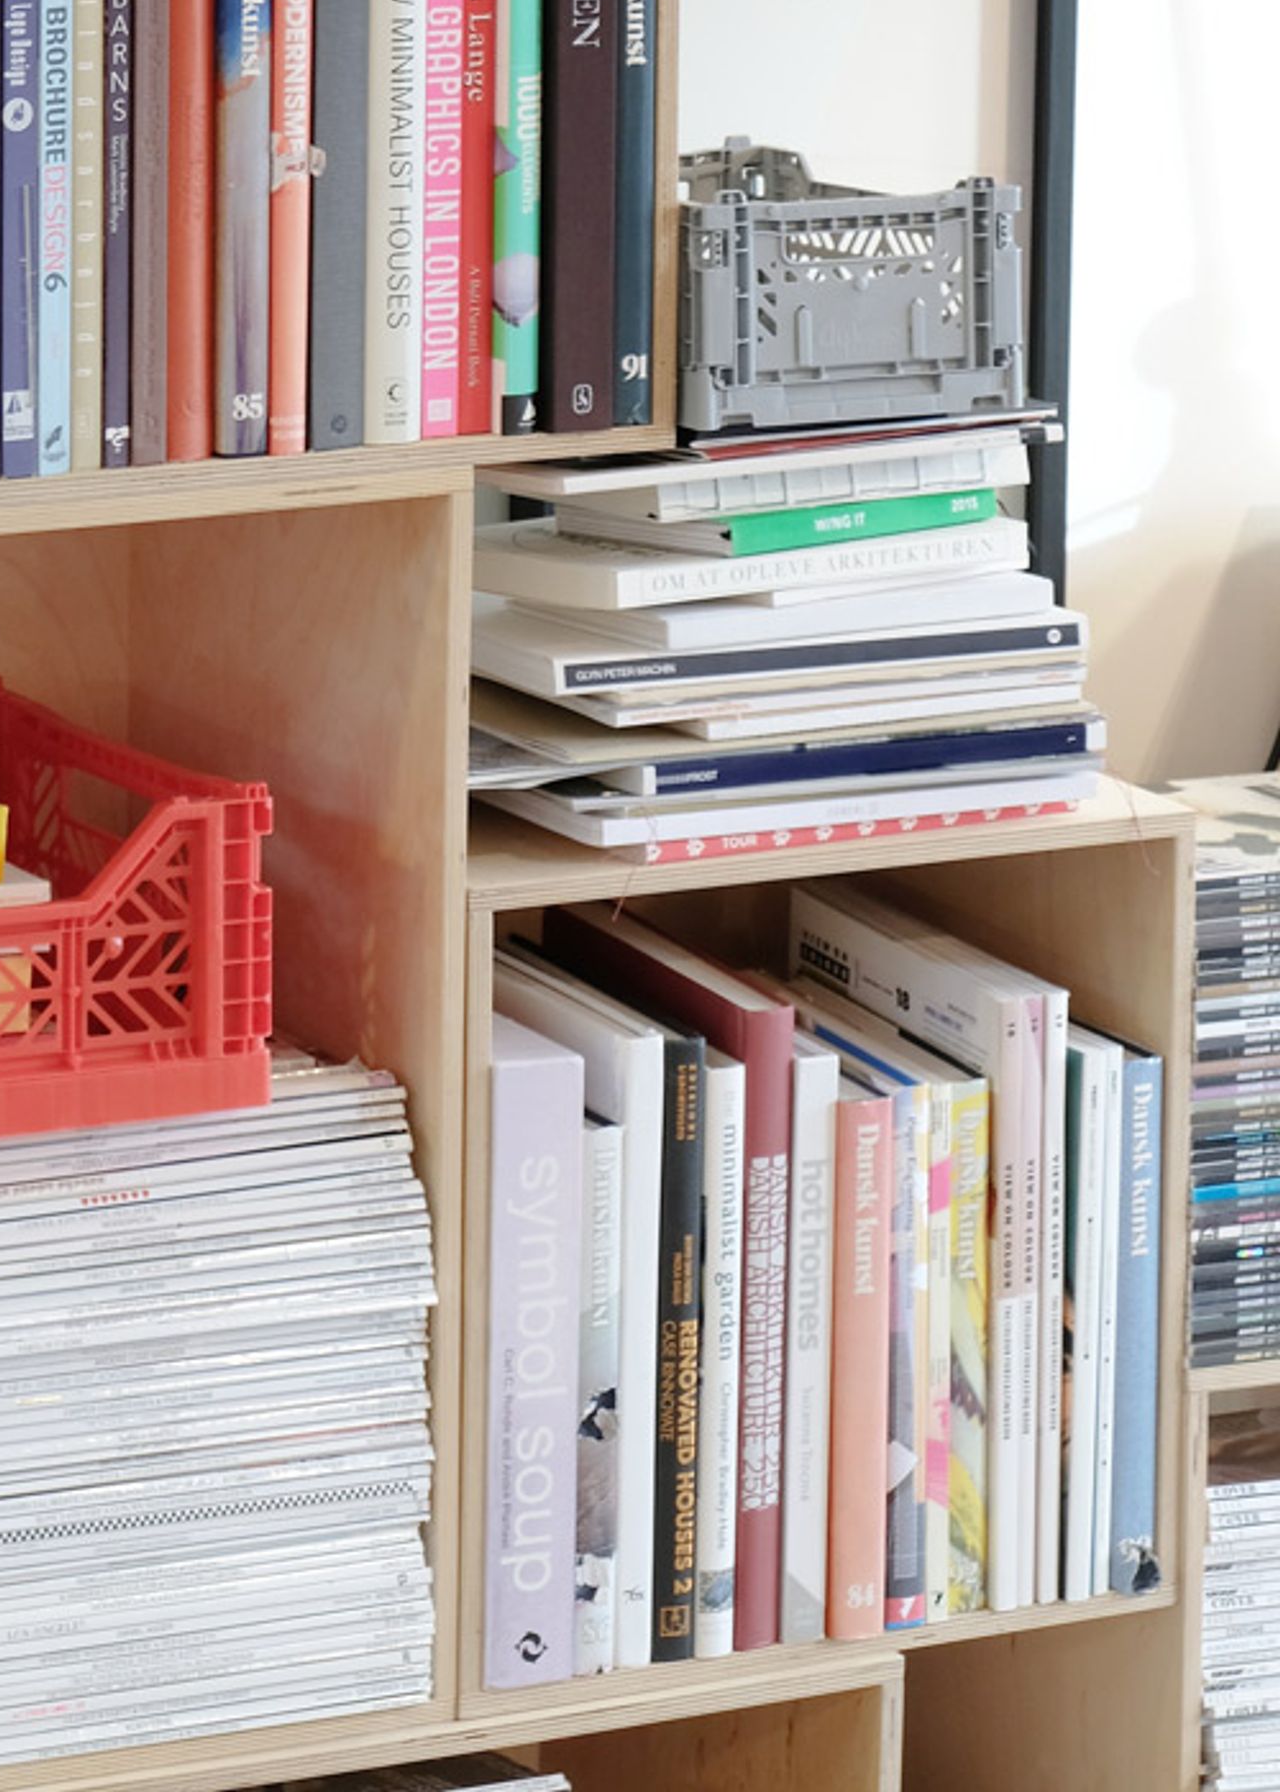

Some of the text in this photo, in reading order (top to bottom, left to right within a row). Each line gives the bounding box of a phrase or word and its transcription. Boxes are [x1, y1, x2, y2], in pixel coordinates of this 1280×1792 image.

[388, 19, 414, 194] MINIMALIST
[425, 7, 462, 177] GRAPHICS
[464, 14, 491, 103] Lange
[517, 74, 540, 141] 1000
[425, 189, 460, 220] IN
[387, 206, 412, 330] HOUSES
[424, 236, 460, 371] LONDON
[232, 392, 265, 420] 85
[467, 356, 479, 388] Book
[621, 353, 648, 382] 91
[650, 535, 996, 595] OM AT OPLEVE ARKITEKTUREN
[814, 510, 867, 533] WING IT
[603, 667, 635, 680] PETER
[721, 833, 757, 850] TOUR
[854, 1123, 880, 1295] Dansk kunst
[957, 1110, 980, 1280] Dansk kunst
[1131, 1083, 1154, 1257] Dansk kunst
[714, 1124, 738, 1361] minimalist garden
[797, 1159, 828, 1351] hot homes
[500, 1155, 569, 1592] symbol soup
[659, 1320, 677, 1443] CASE RINNOVATE
[674, 1319, 697, 1465] RENOVATED
[502, 1437, 514, 1460] and
[673, 1471, 695, 1571] HOUSES
[672, 1579, 693, 1595] 2
